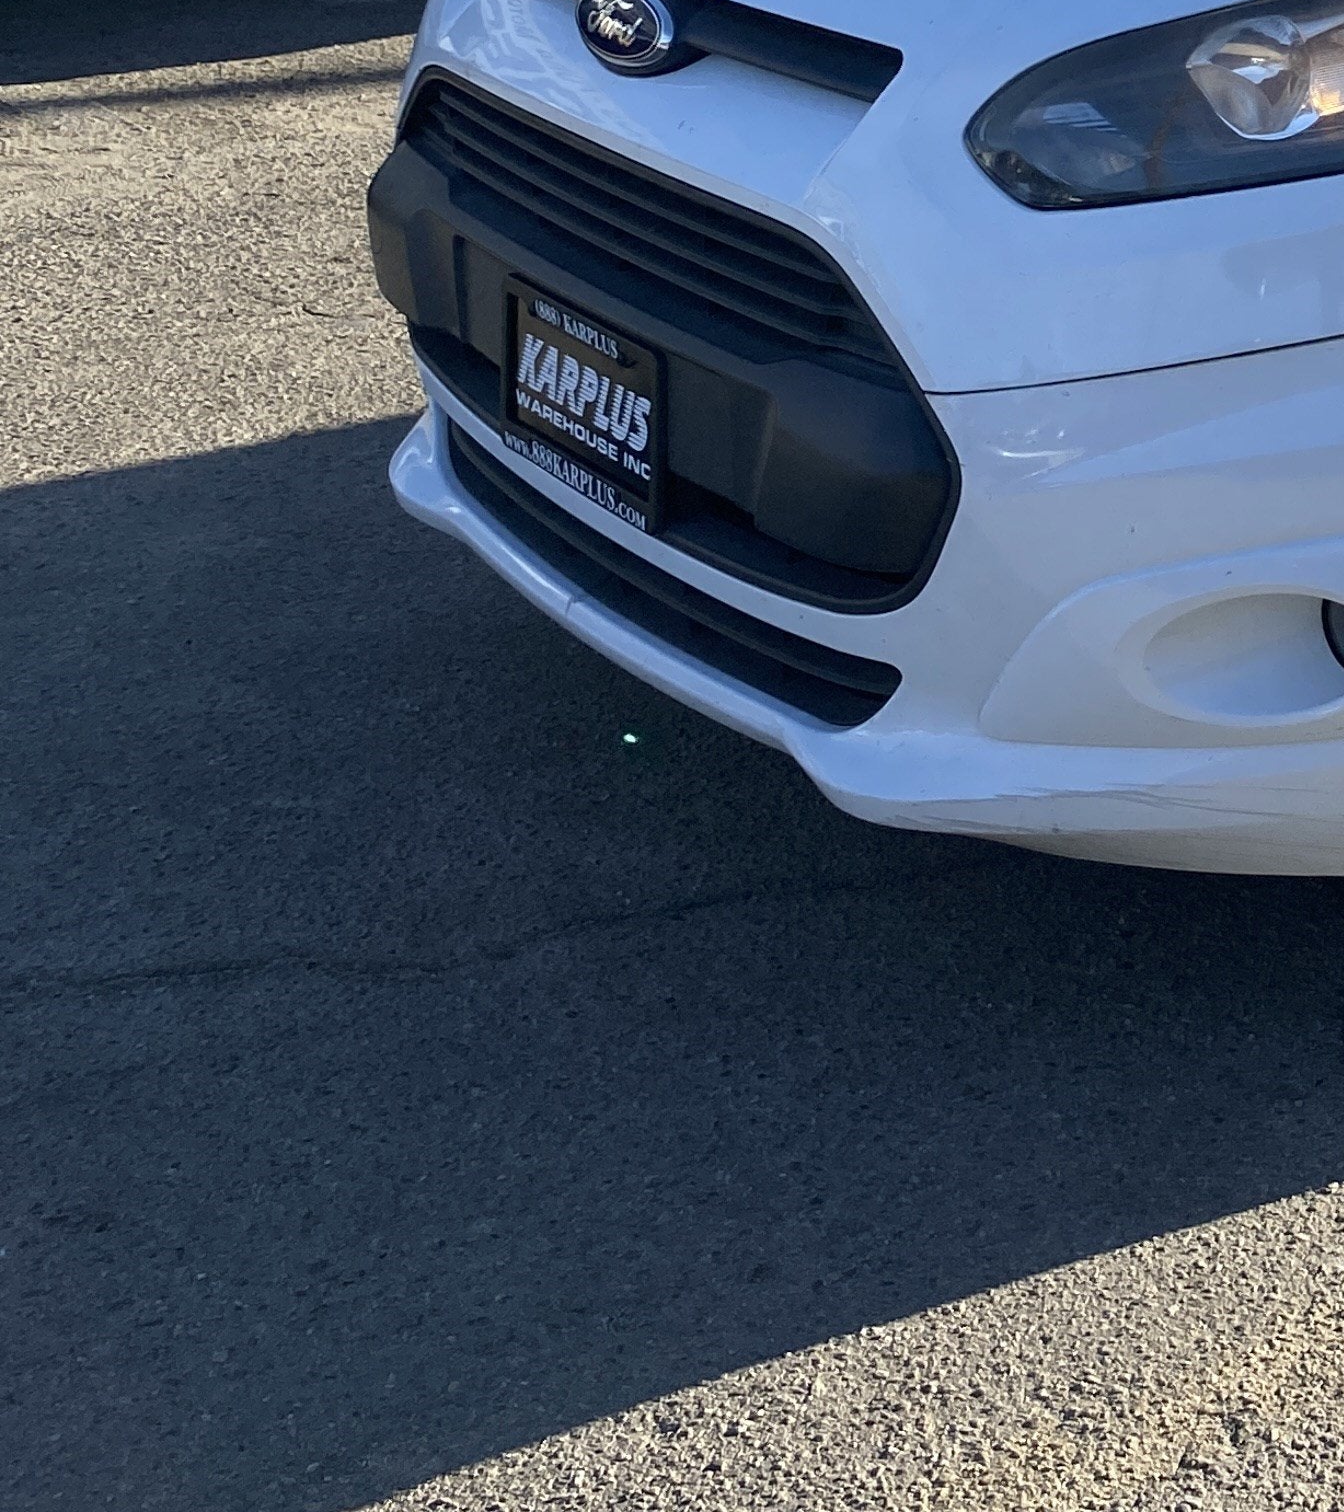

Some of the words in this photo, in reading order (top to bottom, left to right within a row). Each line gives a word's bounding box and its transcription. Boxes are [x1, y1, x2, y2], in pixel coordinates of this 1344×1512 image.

[534, 298, 562, 326] (888)
[562, 312, 619, 360] KARPLUS
[515, 387, 619, 463] WAREHOUSE
[623, 451, 651, 481] INC
[517, 332, 652, 452] KARPLUS
